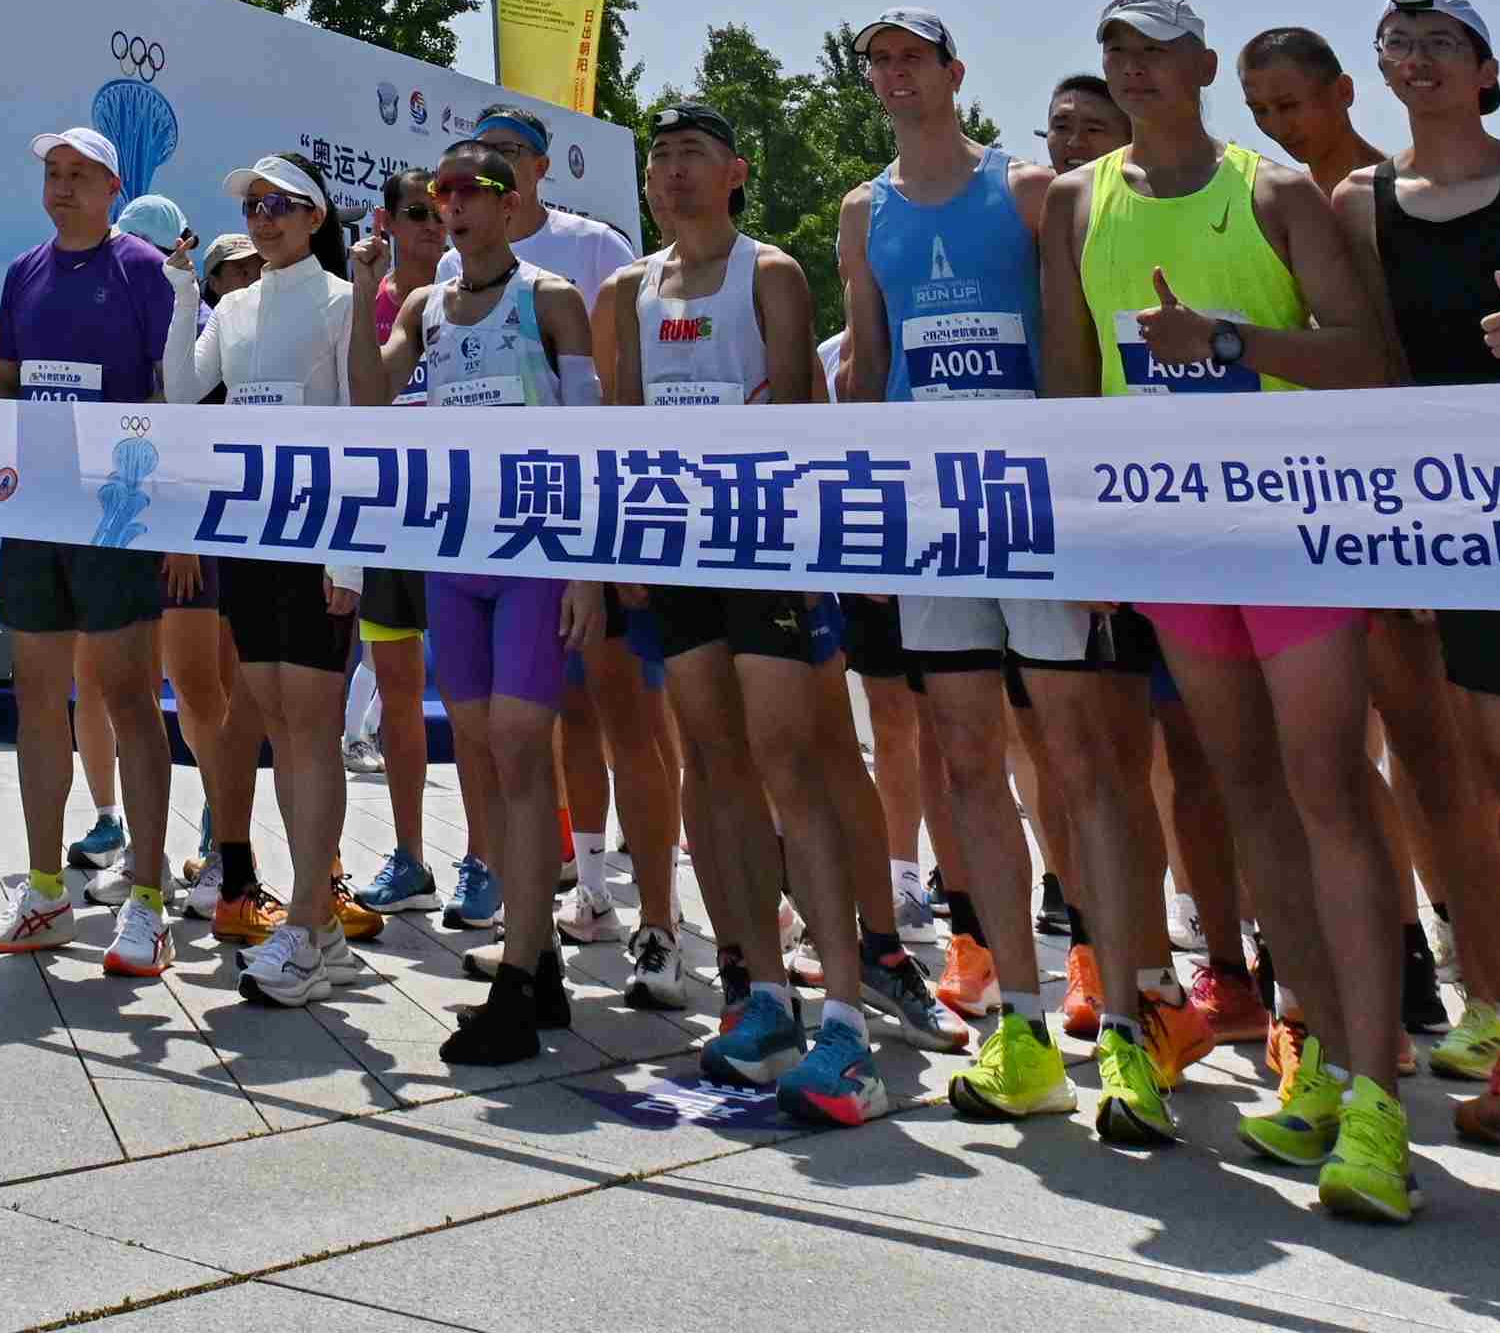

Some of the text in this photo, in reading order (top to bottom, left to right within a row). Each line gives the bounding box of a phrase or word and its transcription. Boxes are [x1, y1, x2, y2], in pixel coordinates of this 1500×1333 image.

[916, 286, 978, 303] RUN UP
[930, 349, 1004, 379] A001
[1093, 462, 1209, 505] 2024
[1219, 455, 1404, 514] Beijing
